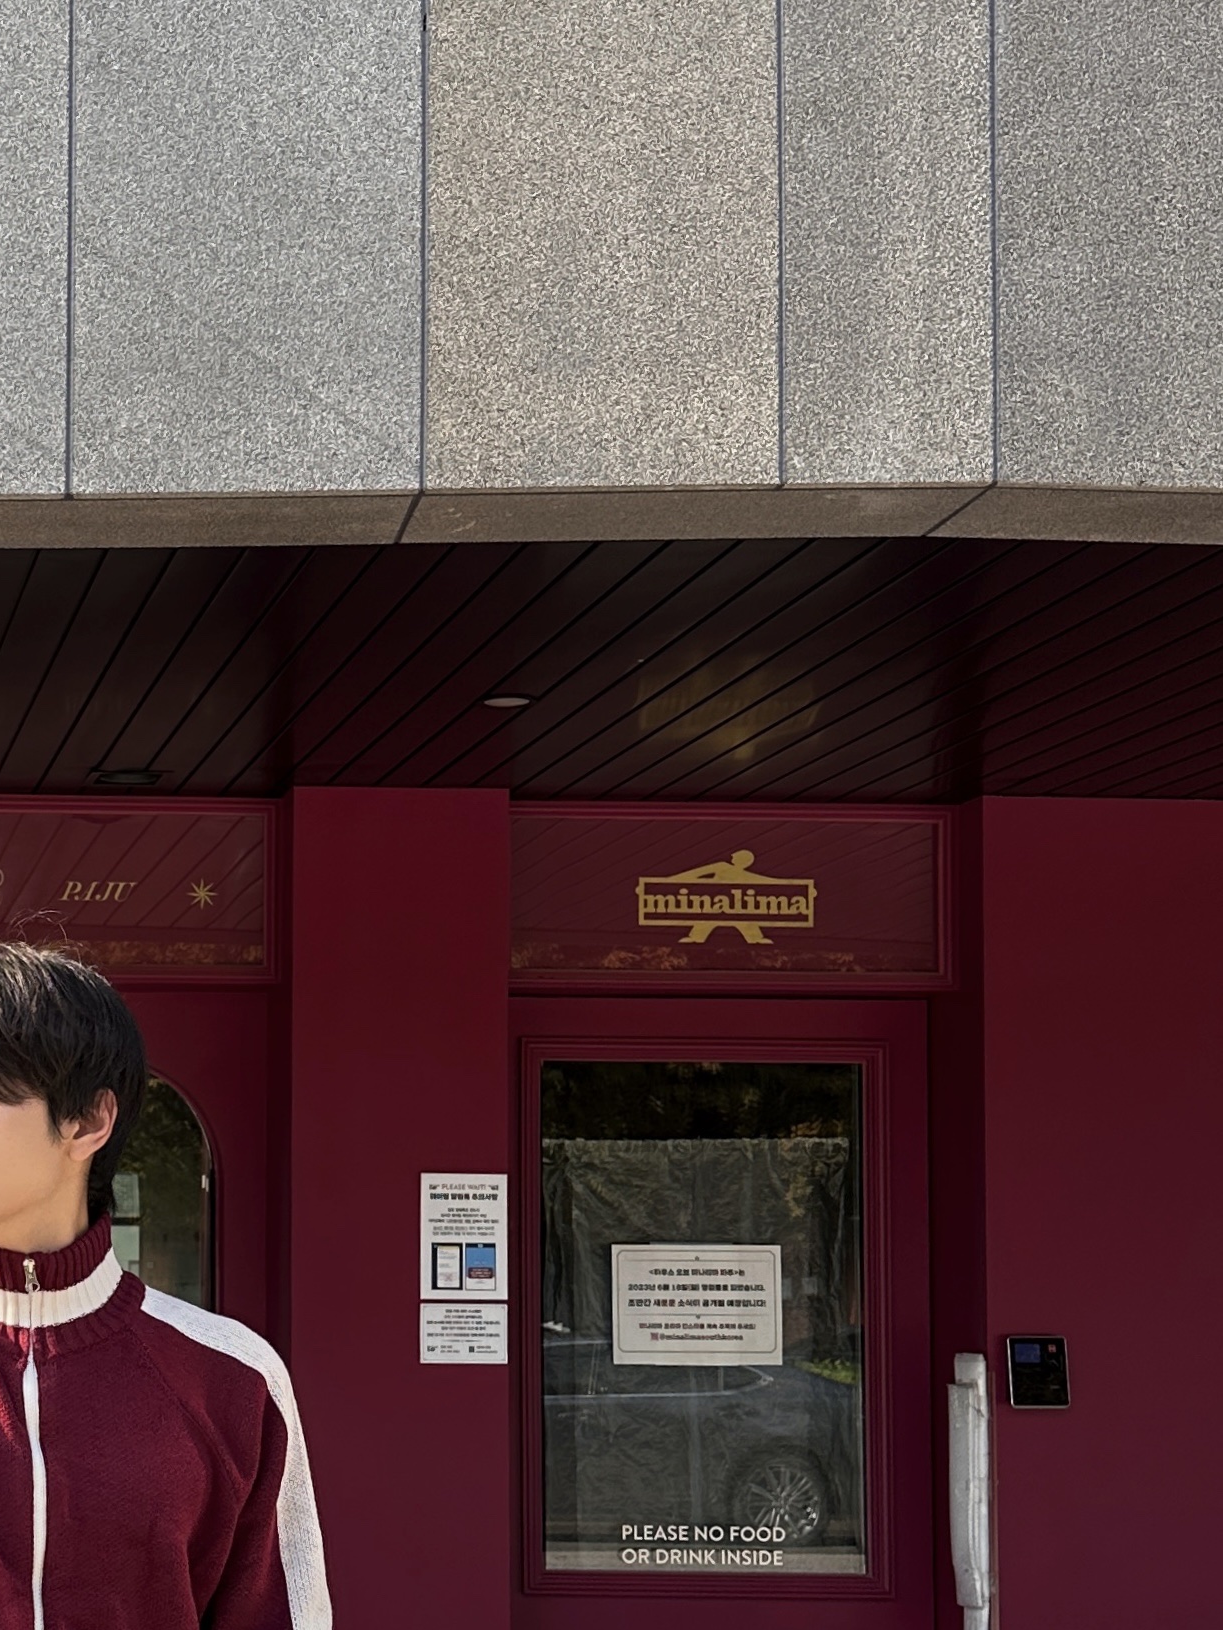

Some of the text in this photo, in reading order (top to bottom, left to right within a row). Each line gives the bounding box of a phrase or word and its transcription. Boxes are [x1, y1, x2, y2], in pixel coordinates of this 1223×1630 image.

[59, 881, 137, 903] PAJU
[643, 888, 810, 915] minalima
[621, 1524, 786, 1542] PLEASE NO FOOD
[621, 1548, 784, 1566] OR DRINK INSIDE
